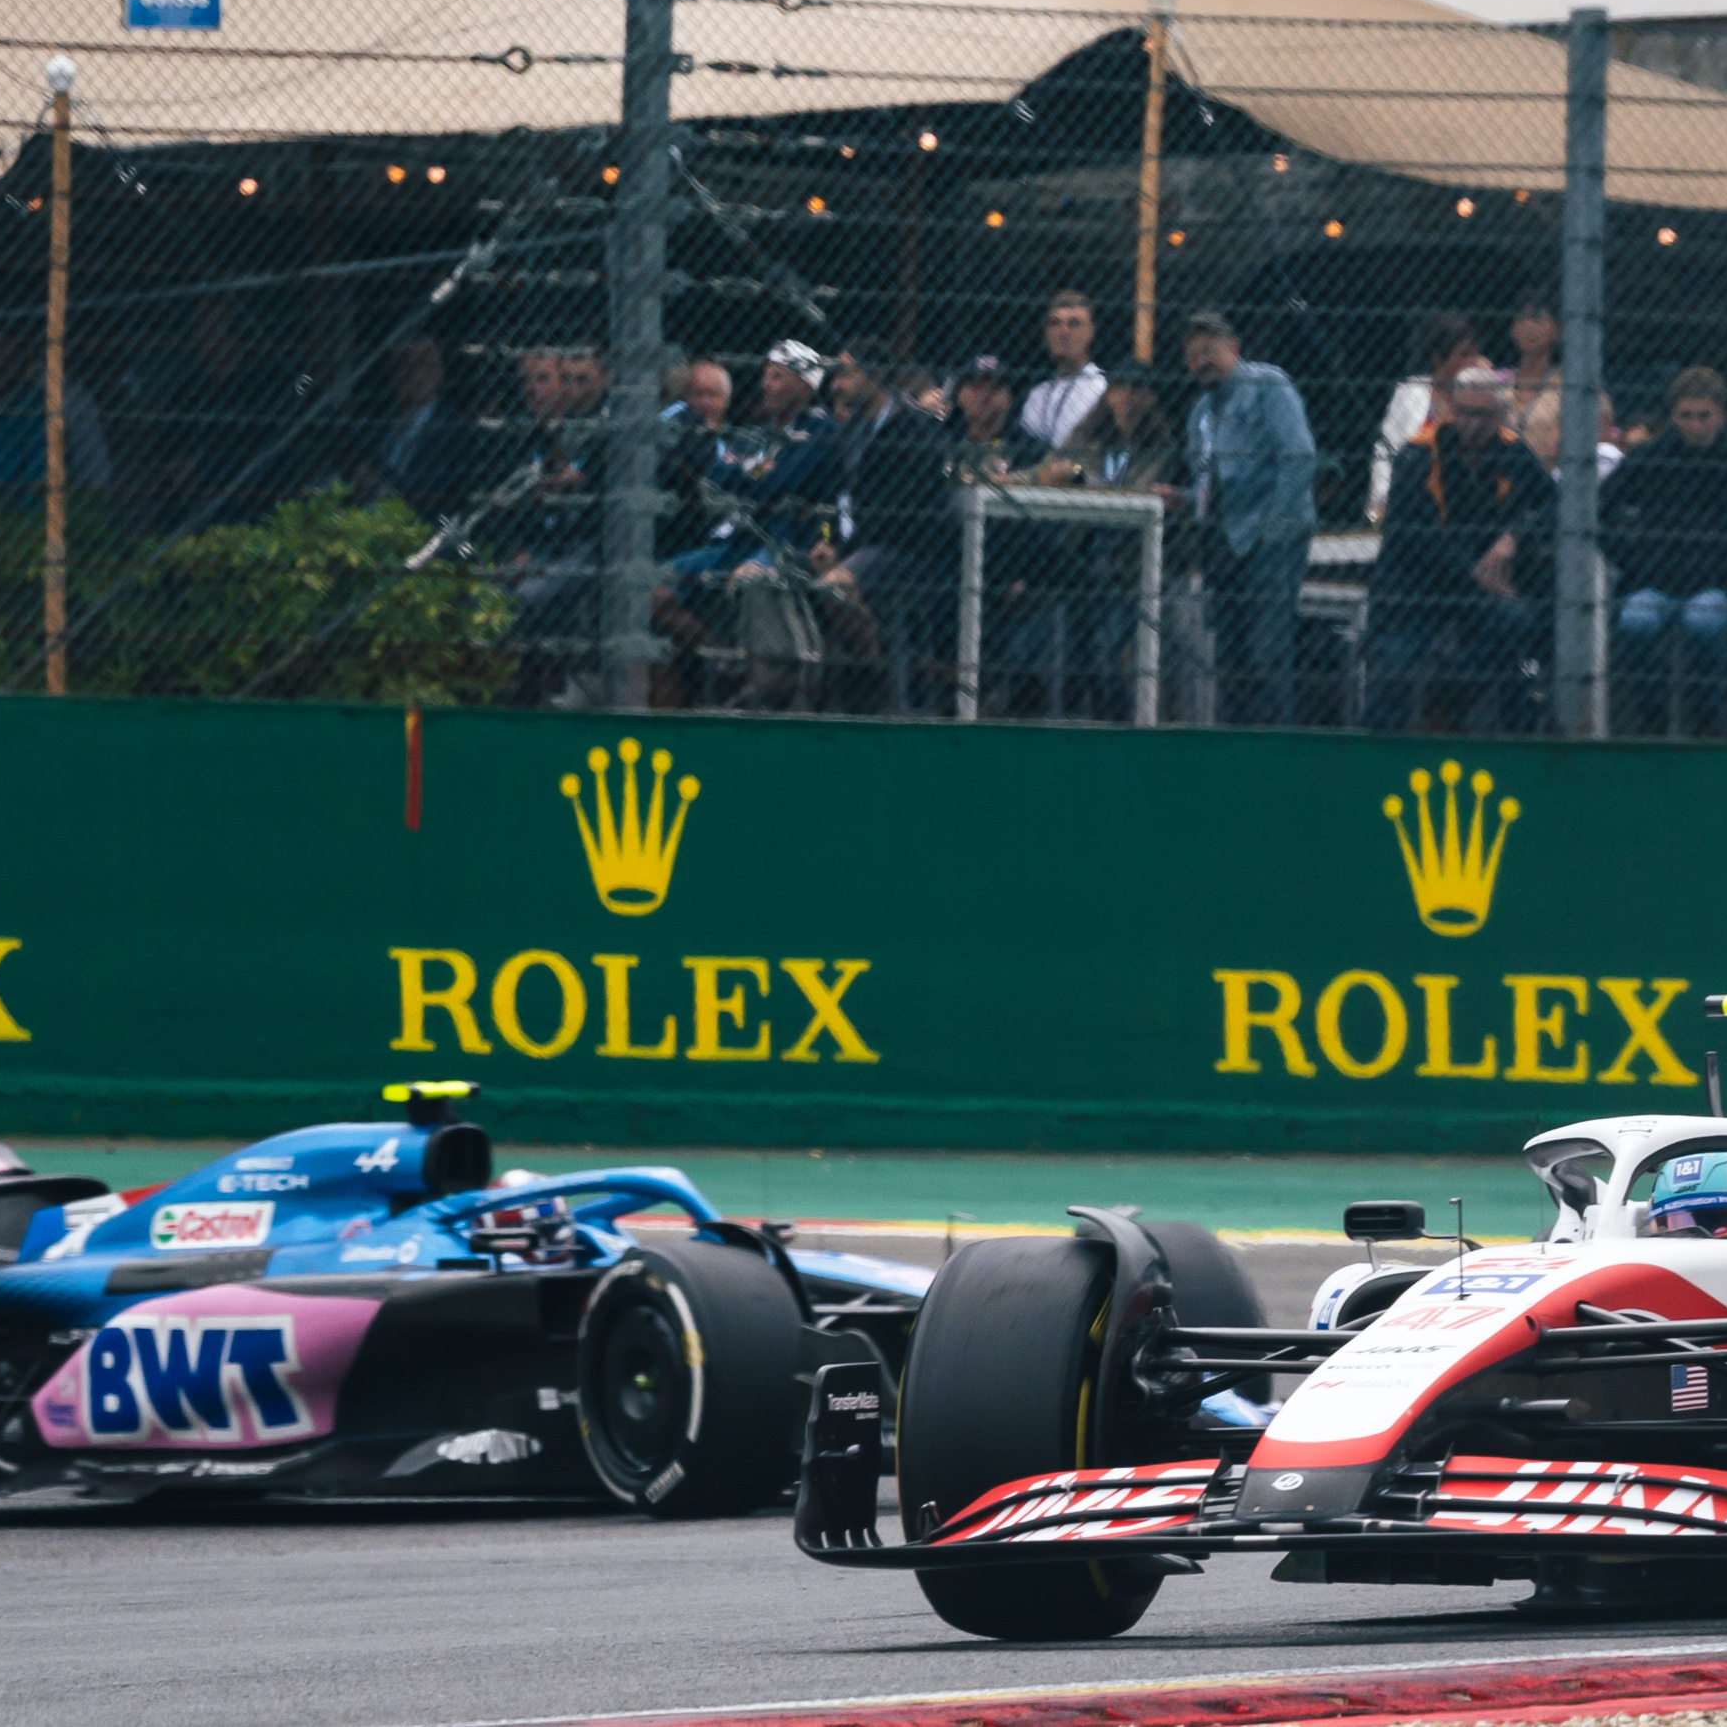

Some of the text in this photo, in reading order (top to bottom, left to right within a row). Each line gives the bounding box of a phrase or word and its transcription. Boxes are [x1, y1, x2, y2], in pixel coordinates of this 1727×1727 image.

[388, 945, 880, 1063] ROLEX
[1212, 967, 1699, 1086] ROLEX
[1675, 1160, 1701, 1177] 1&1
[217, 1173, 310, 1194] E-TECH
[1442, 1274, 1531, 1291] 1&1
[1381, 1305, 1507, 1330] 47
[85, 1319, 307, 1440] BWT
